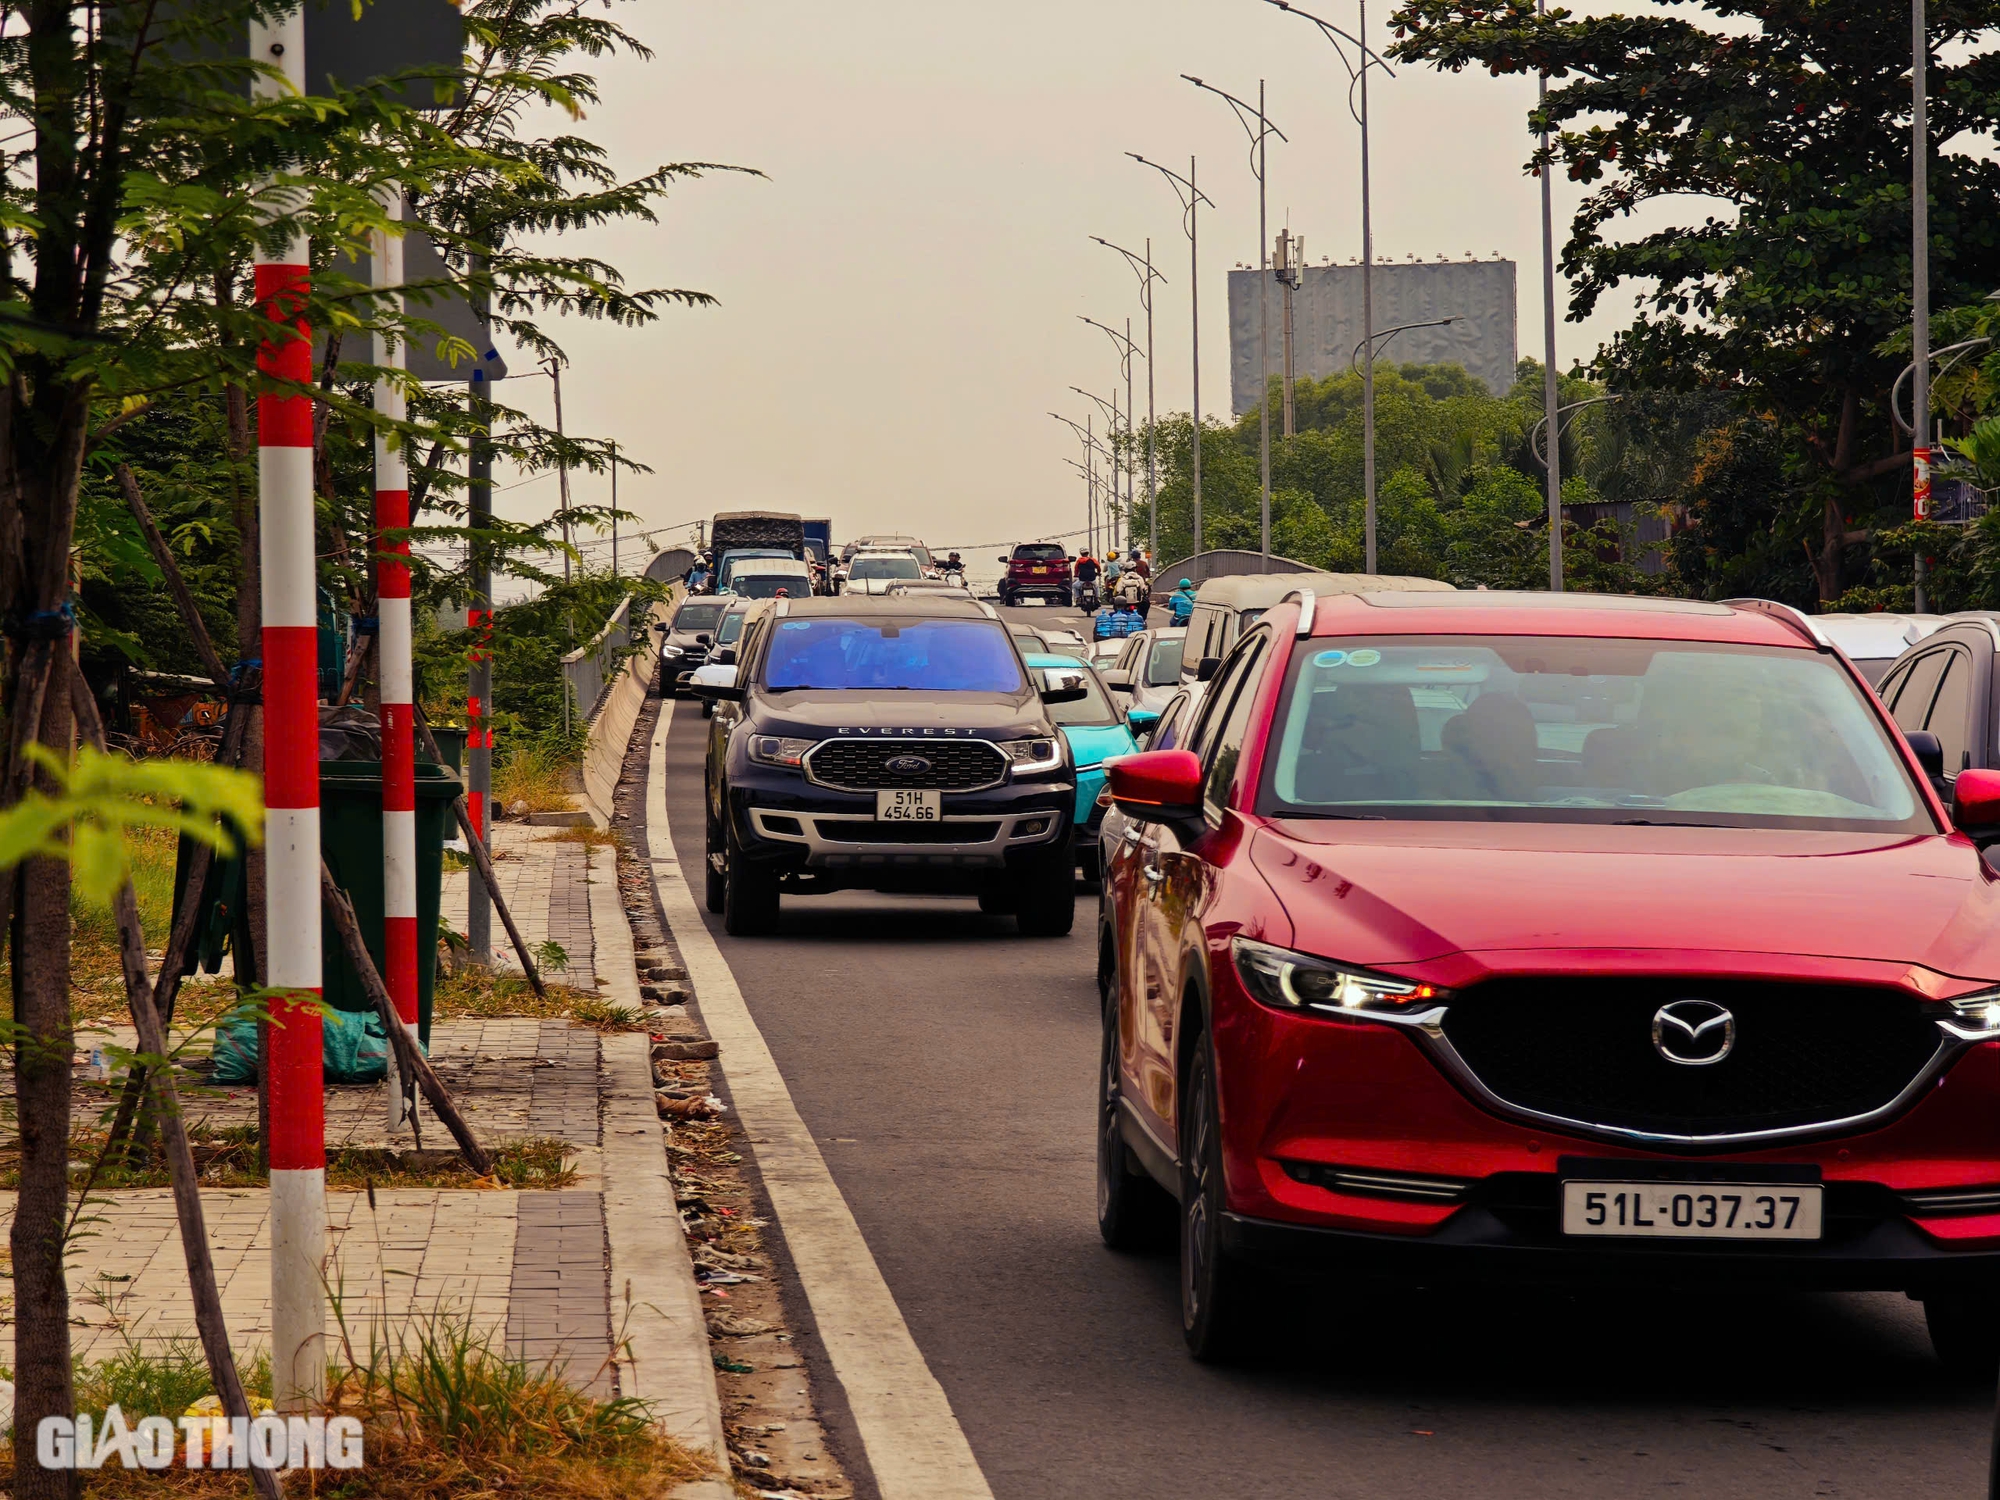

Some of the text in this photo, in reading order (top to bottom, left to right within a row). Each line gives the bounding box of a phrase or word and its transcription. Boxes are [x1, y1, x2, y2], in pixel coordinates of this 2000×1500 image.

[838, 727, 977, 735] EVEREST
[896, 759, 920, 770] Ford
[895, 792, 923, 805] 51H
[884, 806, 934, 820] 454.66
[1585, 1192, 1800, 1229] 51L-037.37
